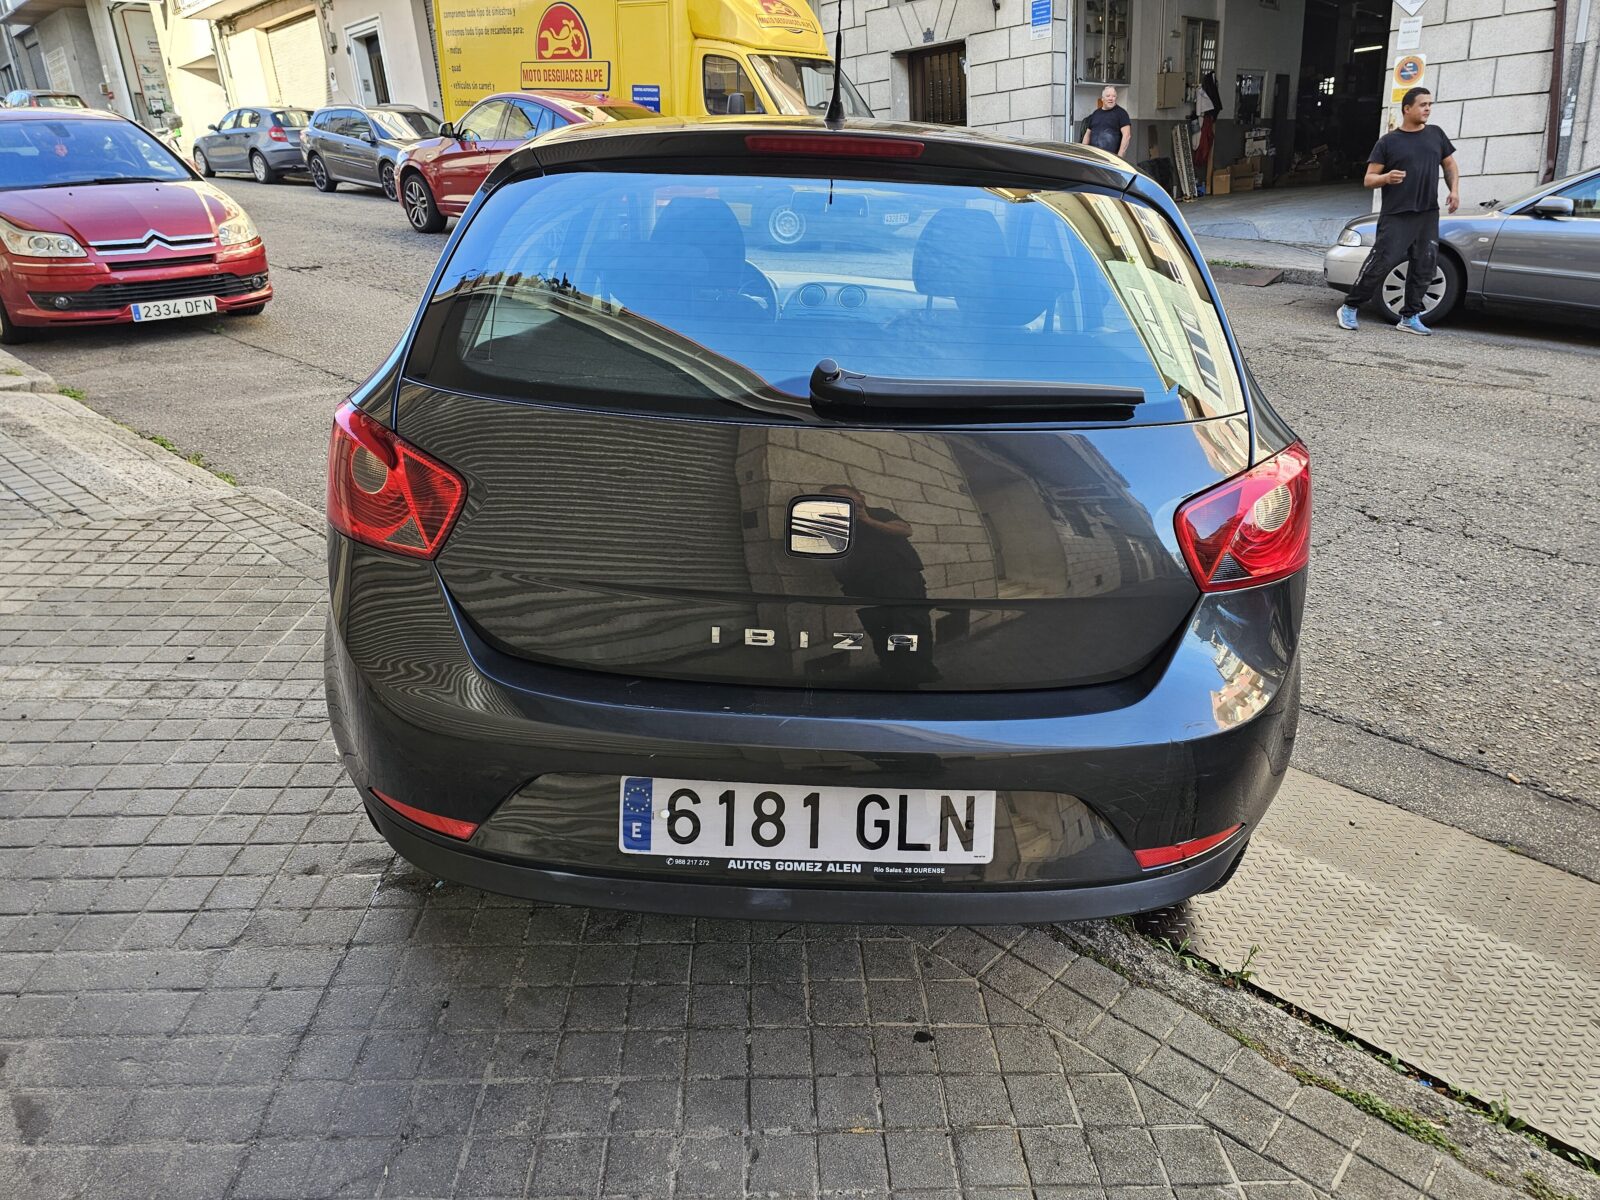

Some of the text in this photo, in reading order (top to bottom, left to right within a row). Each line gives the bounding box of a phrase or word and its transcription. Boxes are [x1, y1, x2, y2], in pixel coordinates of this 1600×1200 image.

[486, 7, 491, 16] de
[484, 25, 490, 35] de
[490, 25, 512, 35] recambios
[451, 64, 461, 73] quad
[522, 69, 603, 83] MOTO DESGUACES ALPE
[143, 299, 213, 318] 2334 DFN
[711, 626, 919, 651] IBIZA
[632, 788, 976, 852] E 6181 GLN
[727, 859, 771, 870] AUTOS
[775, 861, 823, 871] GOMEZ
[826, 862, 861, 873] ALEN
